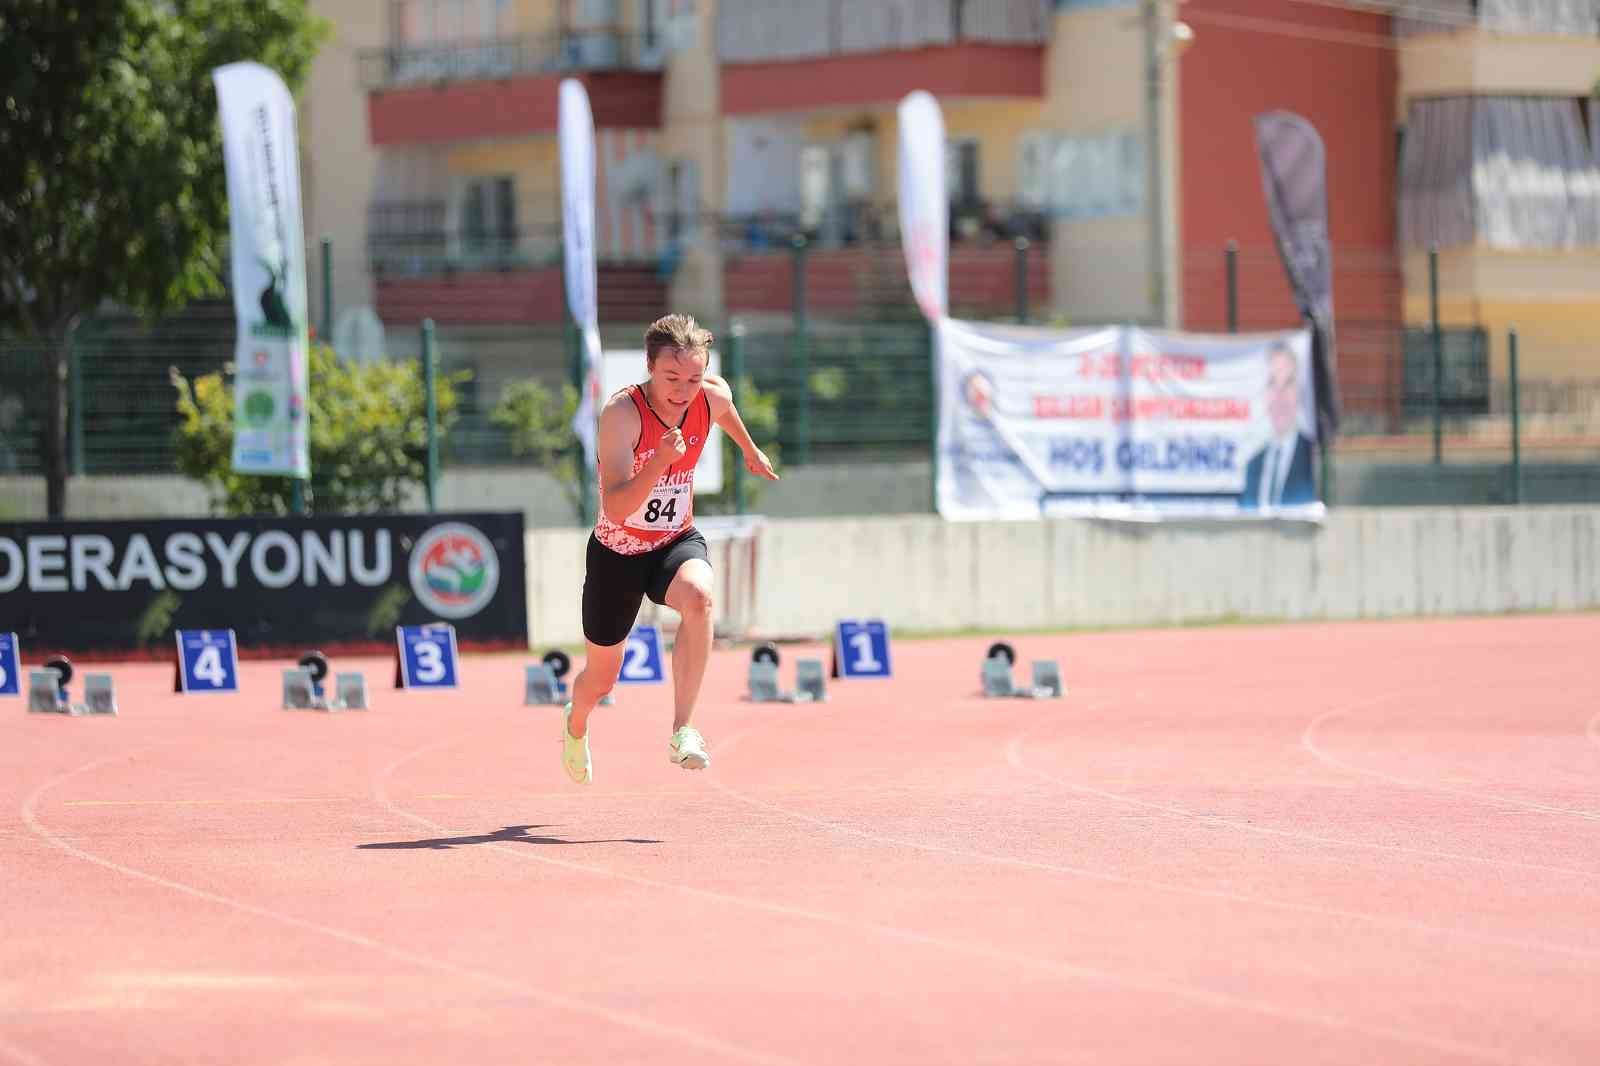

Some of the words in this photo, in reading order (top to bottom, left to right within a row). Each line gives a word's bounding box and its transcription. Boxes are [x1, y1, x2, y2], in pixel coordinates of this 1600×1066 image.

[1049, 436, 1104, 474] HOŞ
[655, 469, 694, 487] RKİYE
[644, 497, 676, 523] 84
[193, 645, 228, 688] 4
[413, 640, 446, 683] 3
[623, 638, 655, 679] 2
[849, 632, 882, 672] 1
